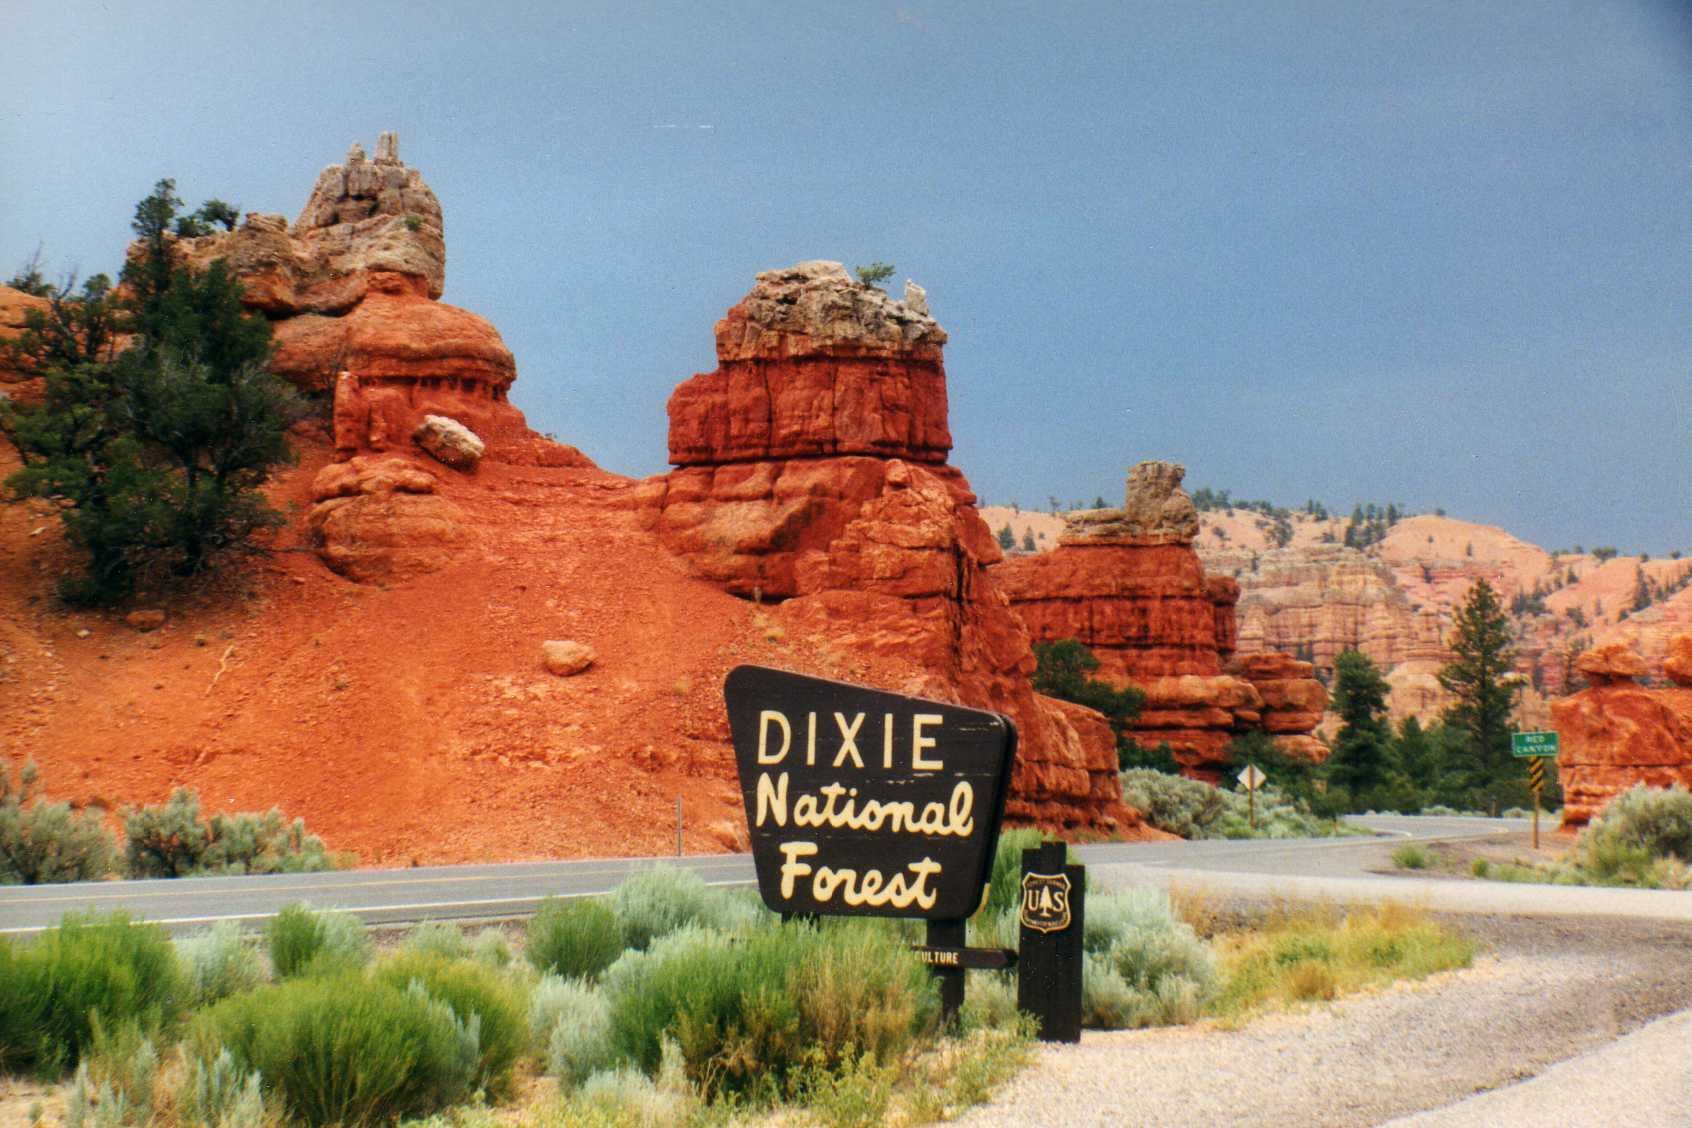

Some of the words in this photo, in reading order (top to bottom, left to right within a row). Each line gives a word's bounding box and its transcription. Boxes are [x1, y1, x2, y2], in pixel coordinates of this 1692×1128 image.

[757, 710, 944, 770] DIXIE
[755, 771, 974, 837] National
[778, 841, 942, 909] Forest
